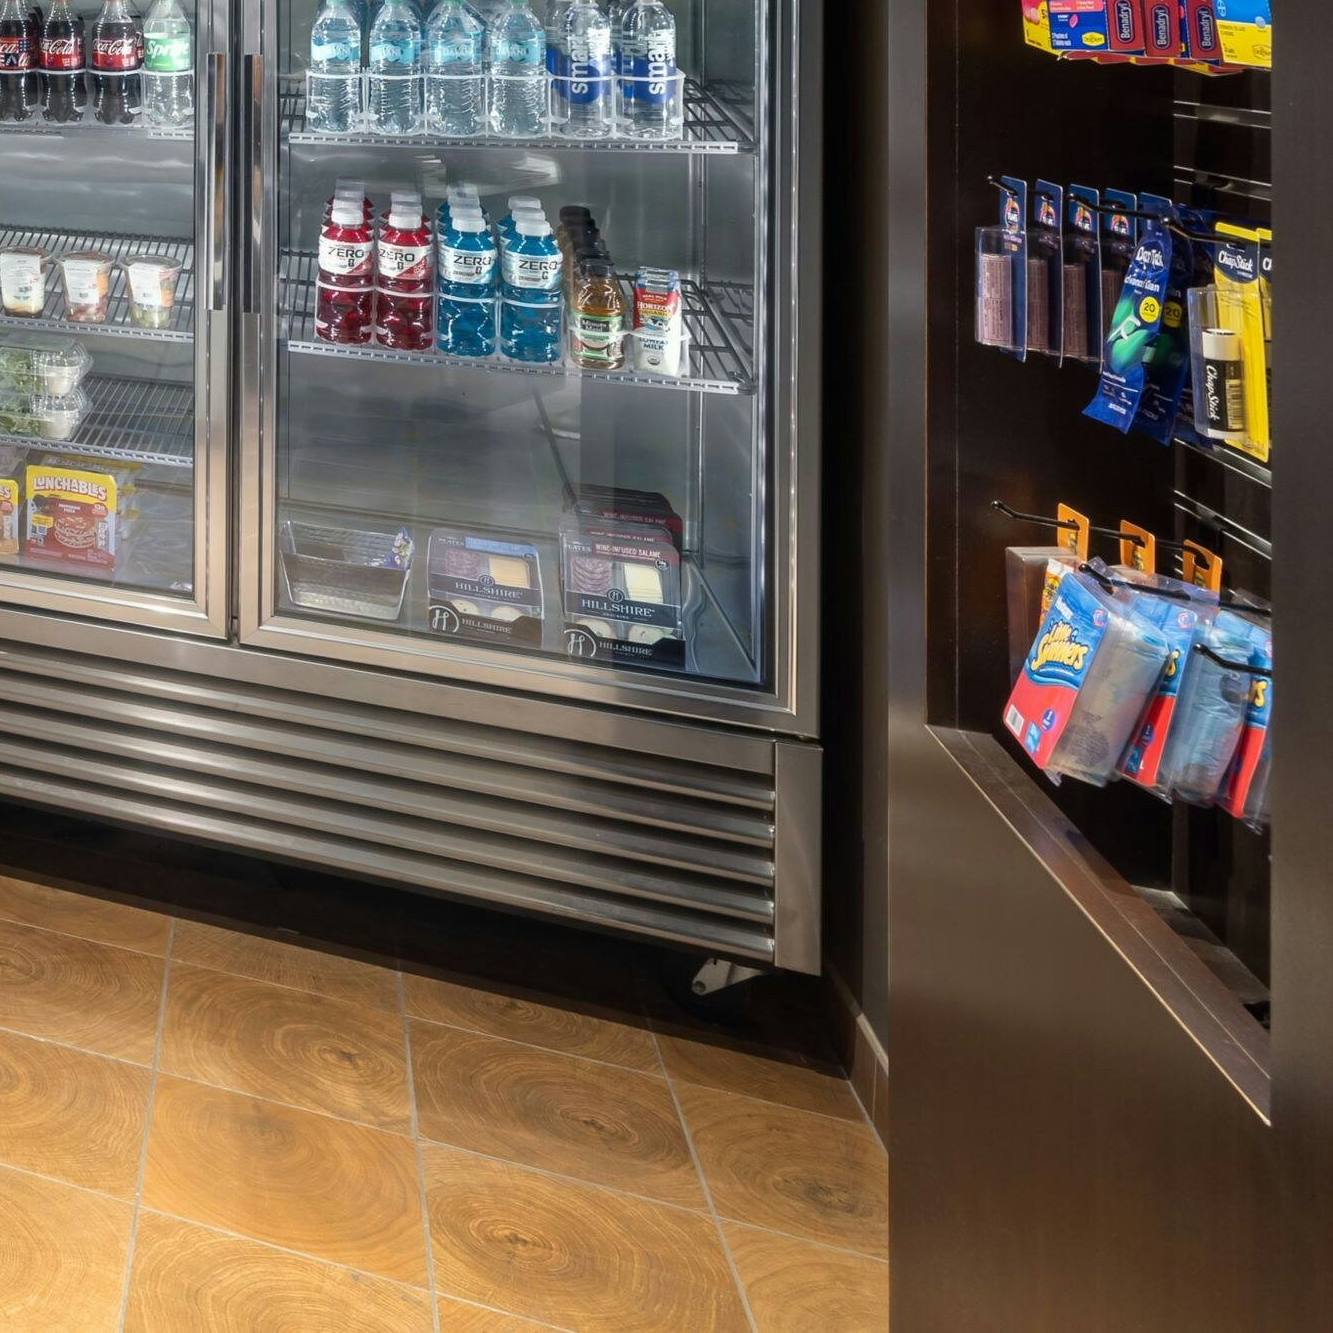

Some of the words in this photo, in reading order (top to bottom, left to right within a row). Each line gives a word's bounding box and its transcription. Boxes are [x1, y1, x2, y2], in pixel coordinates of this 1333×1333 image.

[1120, 0, 1132, 40] Benadryl
[1158, 8, 1169, 47] Benadryl
[1202, 9, 1211, 48] Benadryl
[648, 33, 667, 95] smart
[328, 247, 365, 259] ZERO
[379, 247, 415, 262] ZERO
[454, 254, 492, 266] ZERO
[519, 259, 558, 270] ZERO
[1218, 251, 1253, 273] ChapStick
[1144, 302, 1156, 313] 20
[1206, 366, 1219, 421] ChapStick
[34, 477, 107, 501] LUNCHABLES
[596, 544, 637, 556] WINE-INFUSED
[638, 548, 661, 558] SALAME
[455, 582, 521, 598] HILLSHIRE
[582, 599, 652, 617] HILLSHIRE
[462, 619, 512, 633] HILLSHIRE
[599, 642, 653, 656] HILLSHIRE
